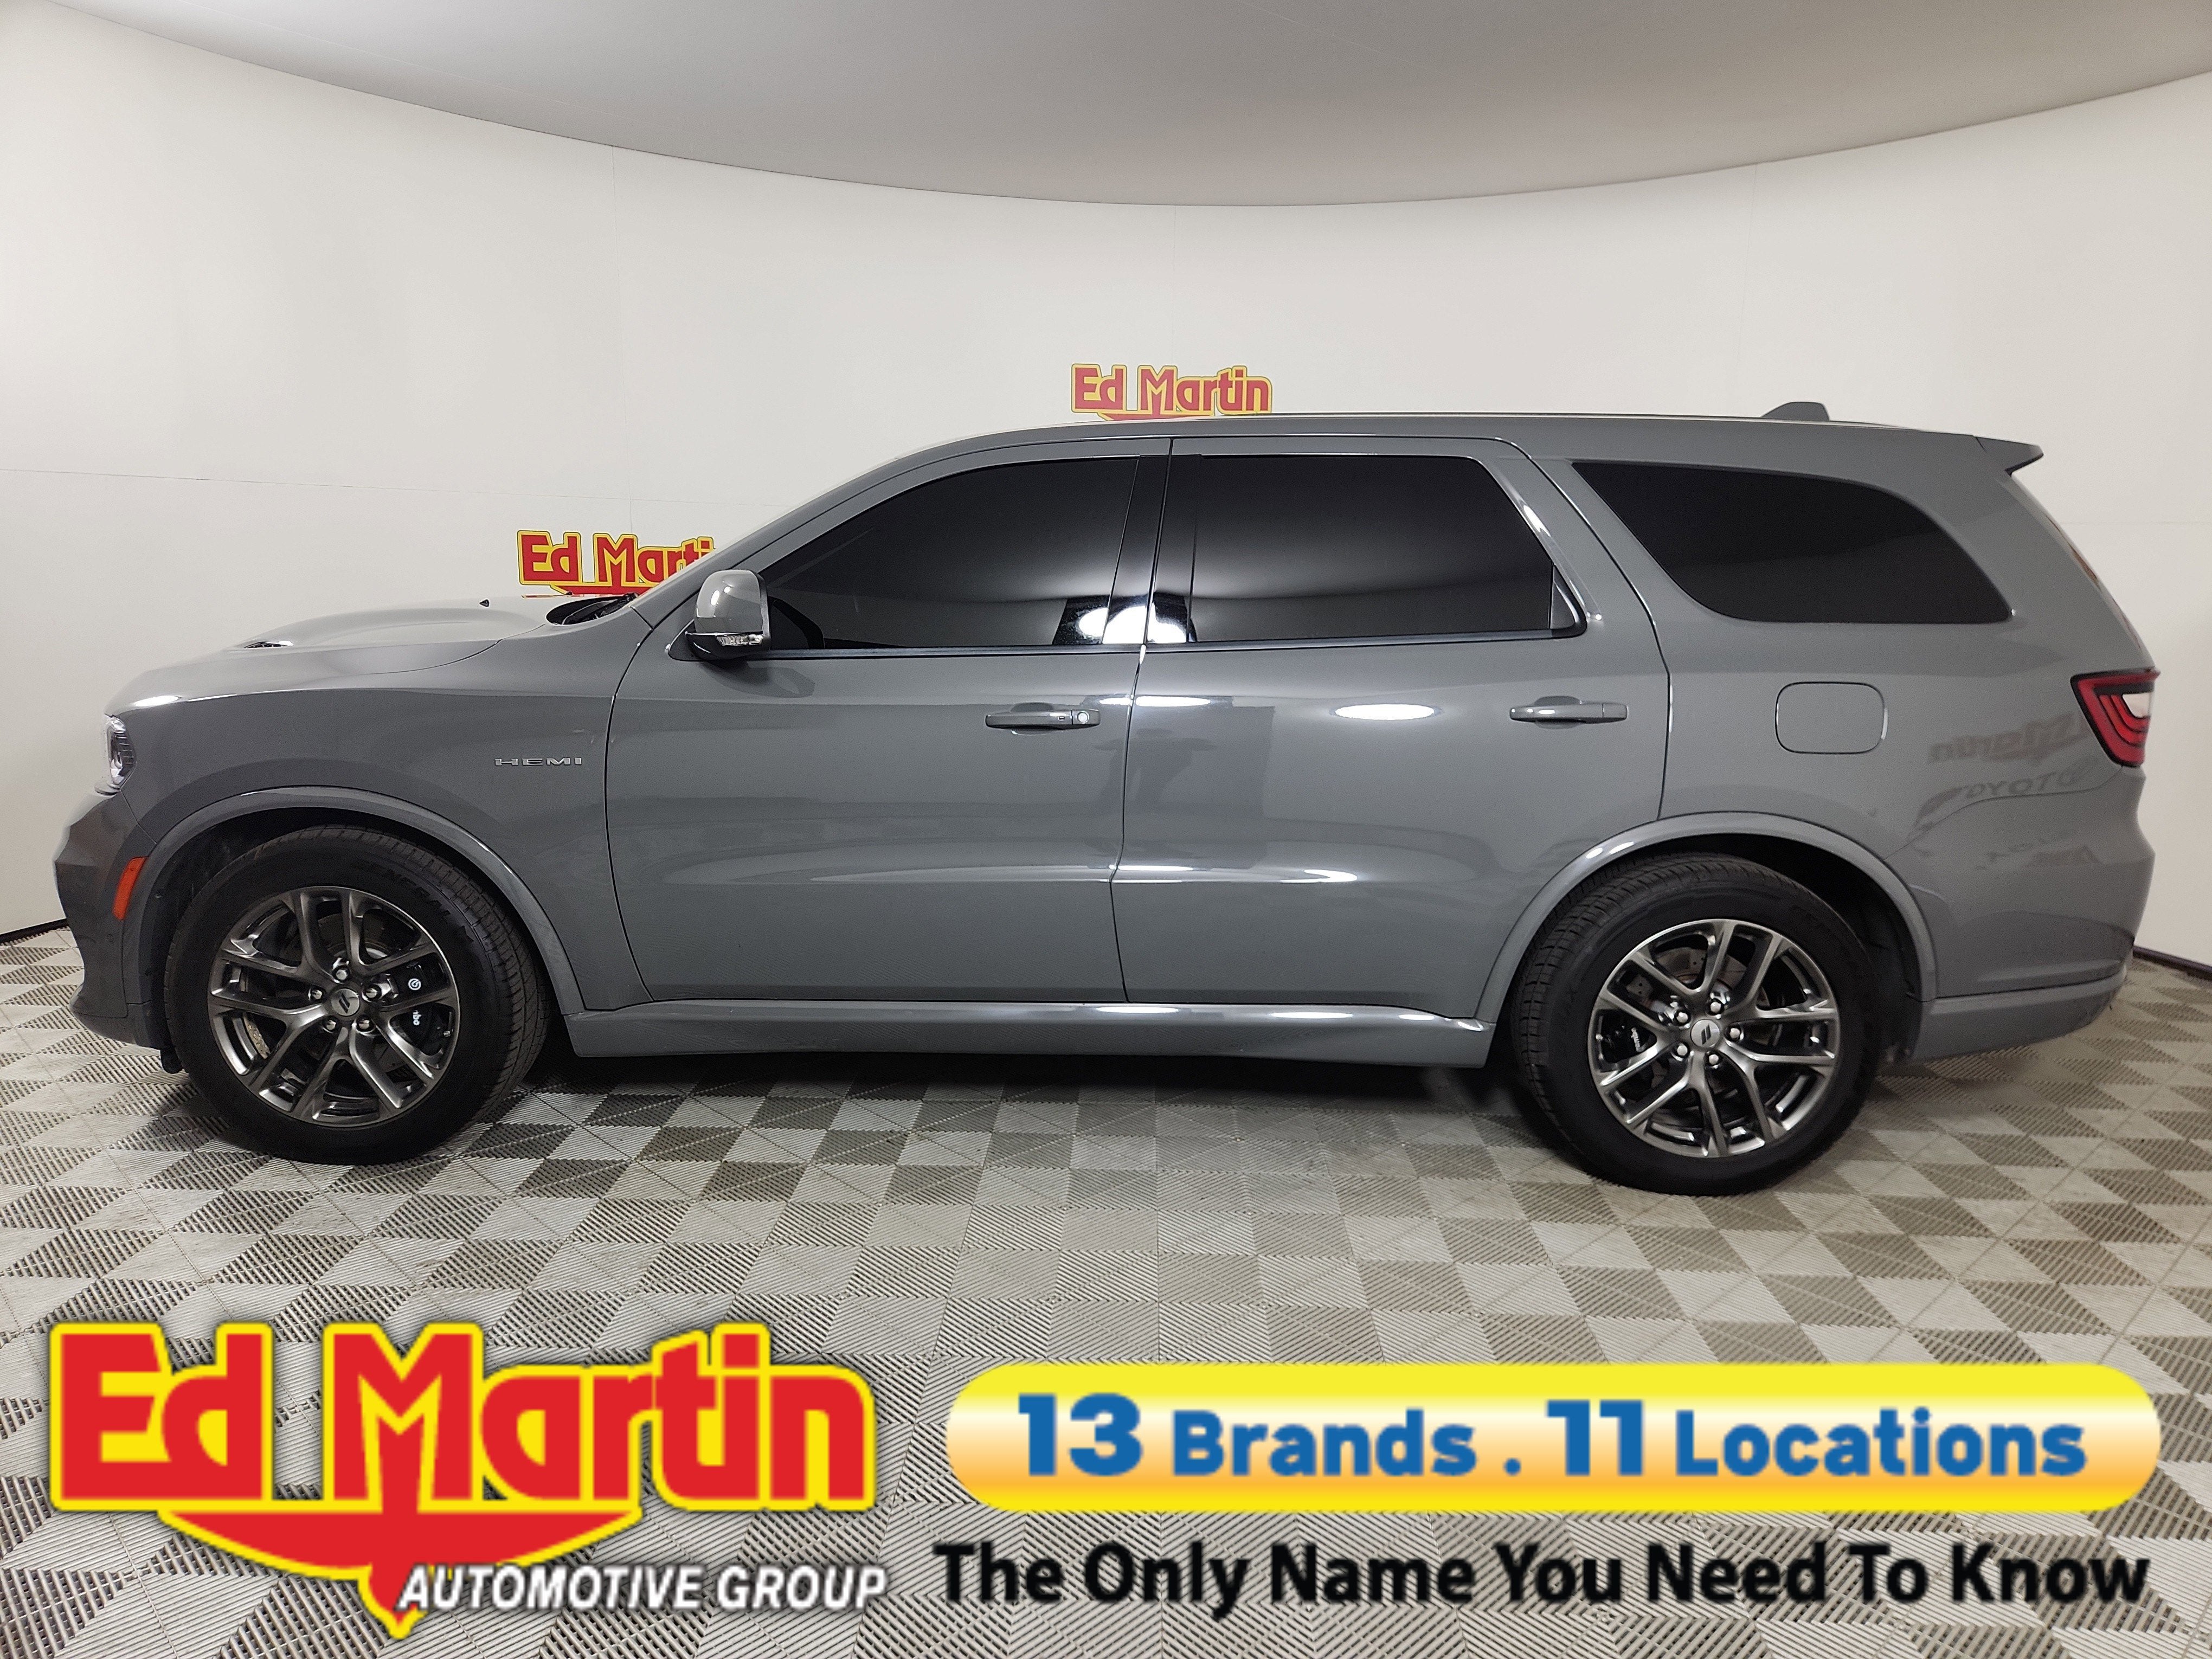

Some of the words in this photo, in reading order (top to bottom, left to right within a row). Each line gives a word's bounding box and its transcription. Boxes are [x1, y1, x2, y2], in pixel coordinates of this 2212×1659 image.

[1073, 366, 1124, 411] Ed
[1139, 366, 1270, 411] Martin
[521, 533, 579, 582] Ed
[596, 535, 712, 583] Marti
[494, 757, 582, 766] HEMI
